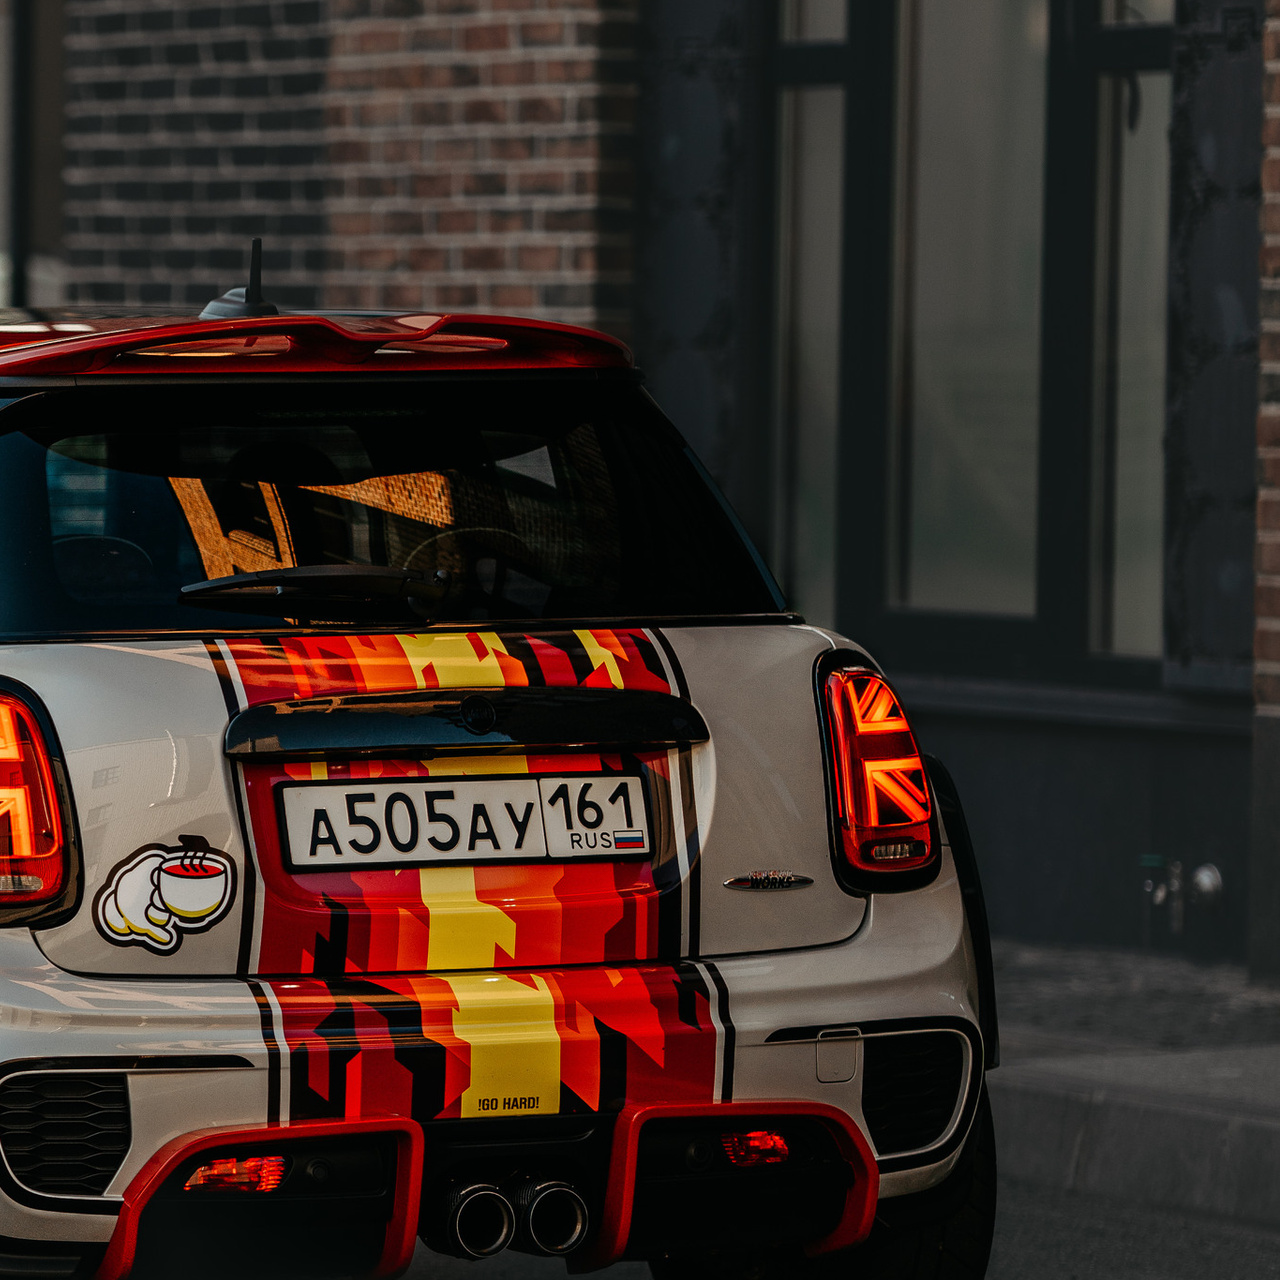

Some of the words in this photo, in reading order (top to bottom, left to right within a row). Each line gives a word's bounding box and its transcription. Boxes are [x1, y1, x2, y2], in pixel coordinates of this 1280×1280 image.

[548, 782, 633, 830] 161
[570, 832, 613, 850] RUS
[478, 1098, 498, 1111] !GO
[502, 1096, 540, 1111] HARD!
